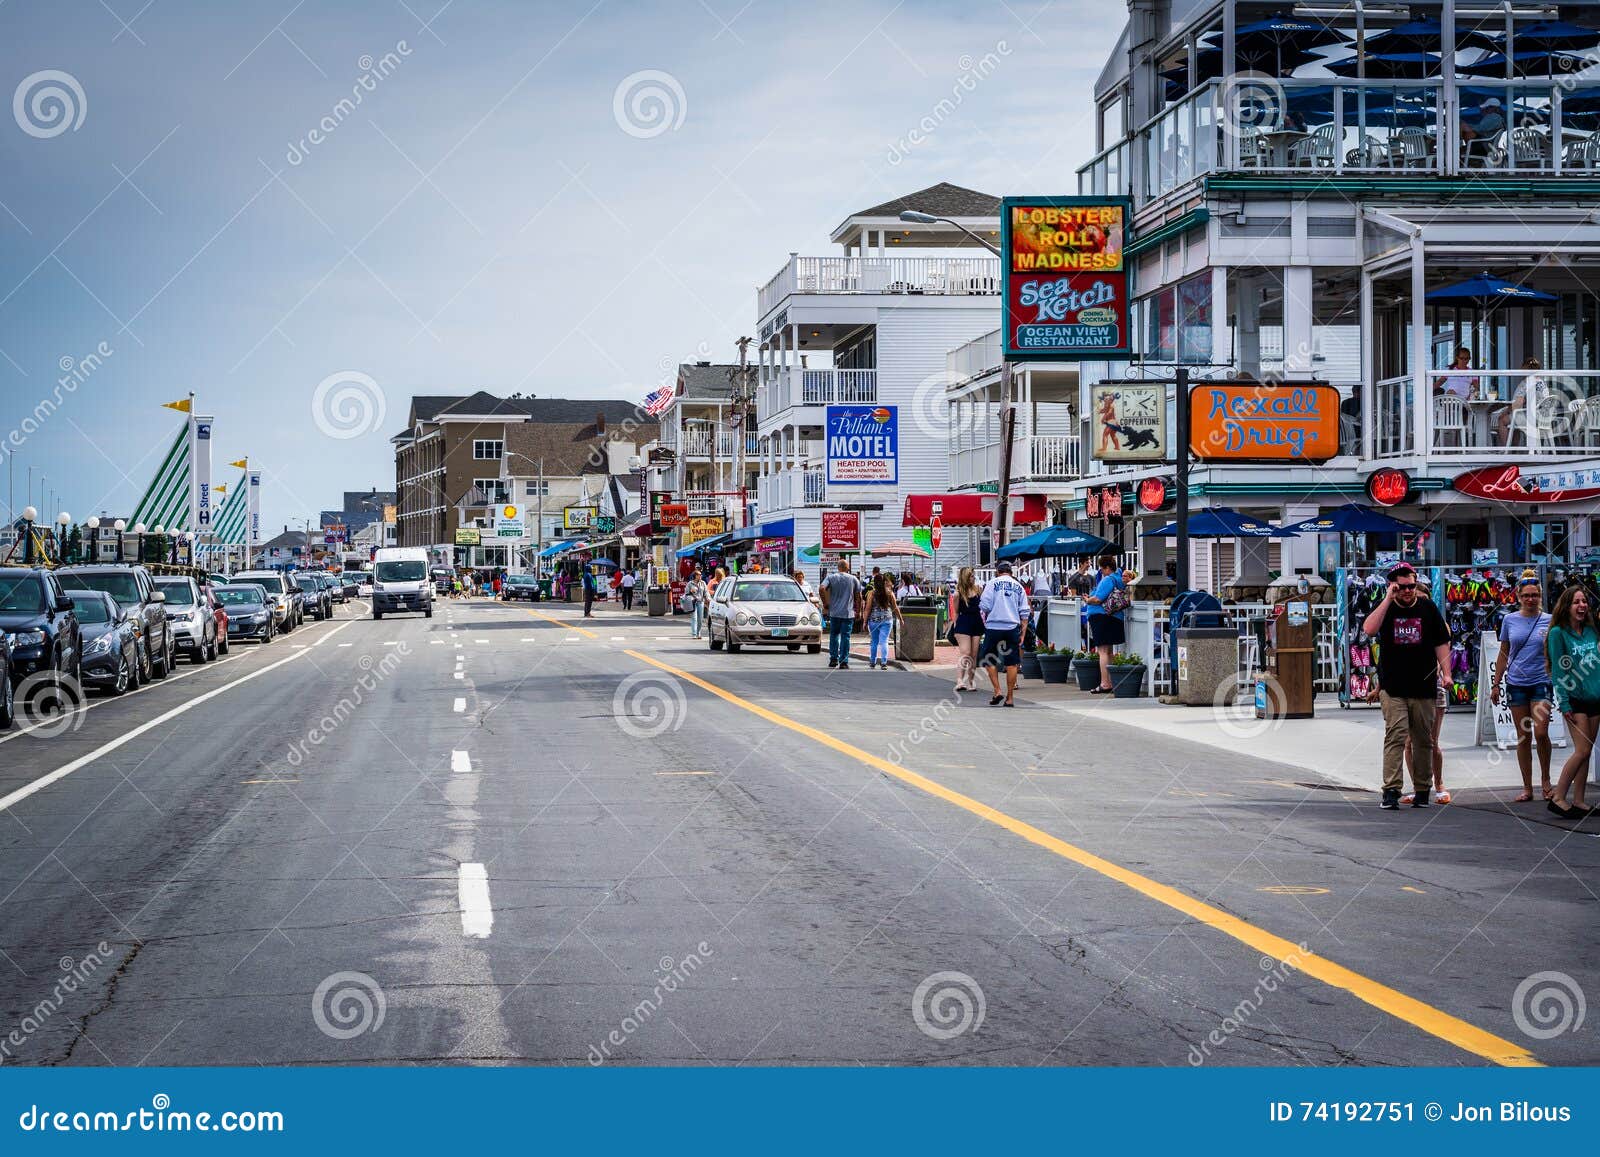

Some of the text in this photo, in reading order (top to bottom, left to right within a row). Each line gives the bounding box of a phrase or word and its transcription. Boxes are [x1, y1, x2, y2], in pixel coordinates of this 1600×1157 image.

[1018, 209, 1113, 224] LOBSTER
[1039, 231, 1093, 246] ROLL
[1018, 253, 1118, 268] MADNESS
[1019, 277, 1070, 306] Sea
[1036, 281, 1116, 322] Ketch
[1026, 327, 1109, 336] OCEAN VIEW
[1024, 336, 1111, 346] RESTAURANT
[1208, 388, 1320, 419] Rexall
[831, 416, 892, 435] Pelham
[1120, 417, 1161, 426] COPPERTONE
[829, 435, 895, 457] MOTEL
[1225, 423, 1319, 457] Drug
[1540, 476, 1550, 488] Beer
[1558, 474, 1566, 487] Ice
[1574, 472, 1584, 488] Toys
[199, 483, 210, 525] H Street
